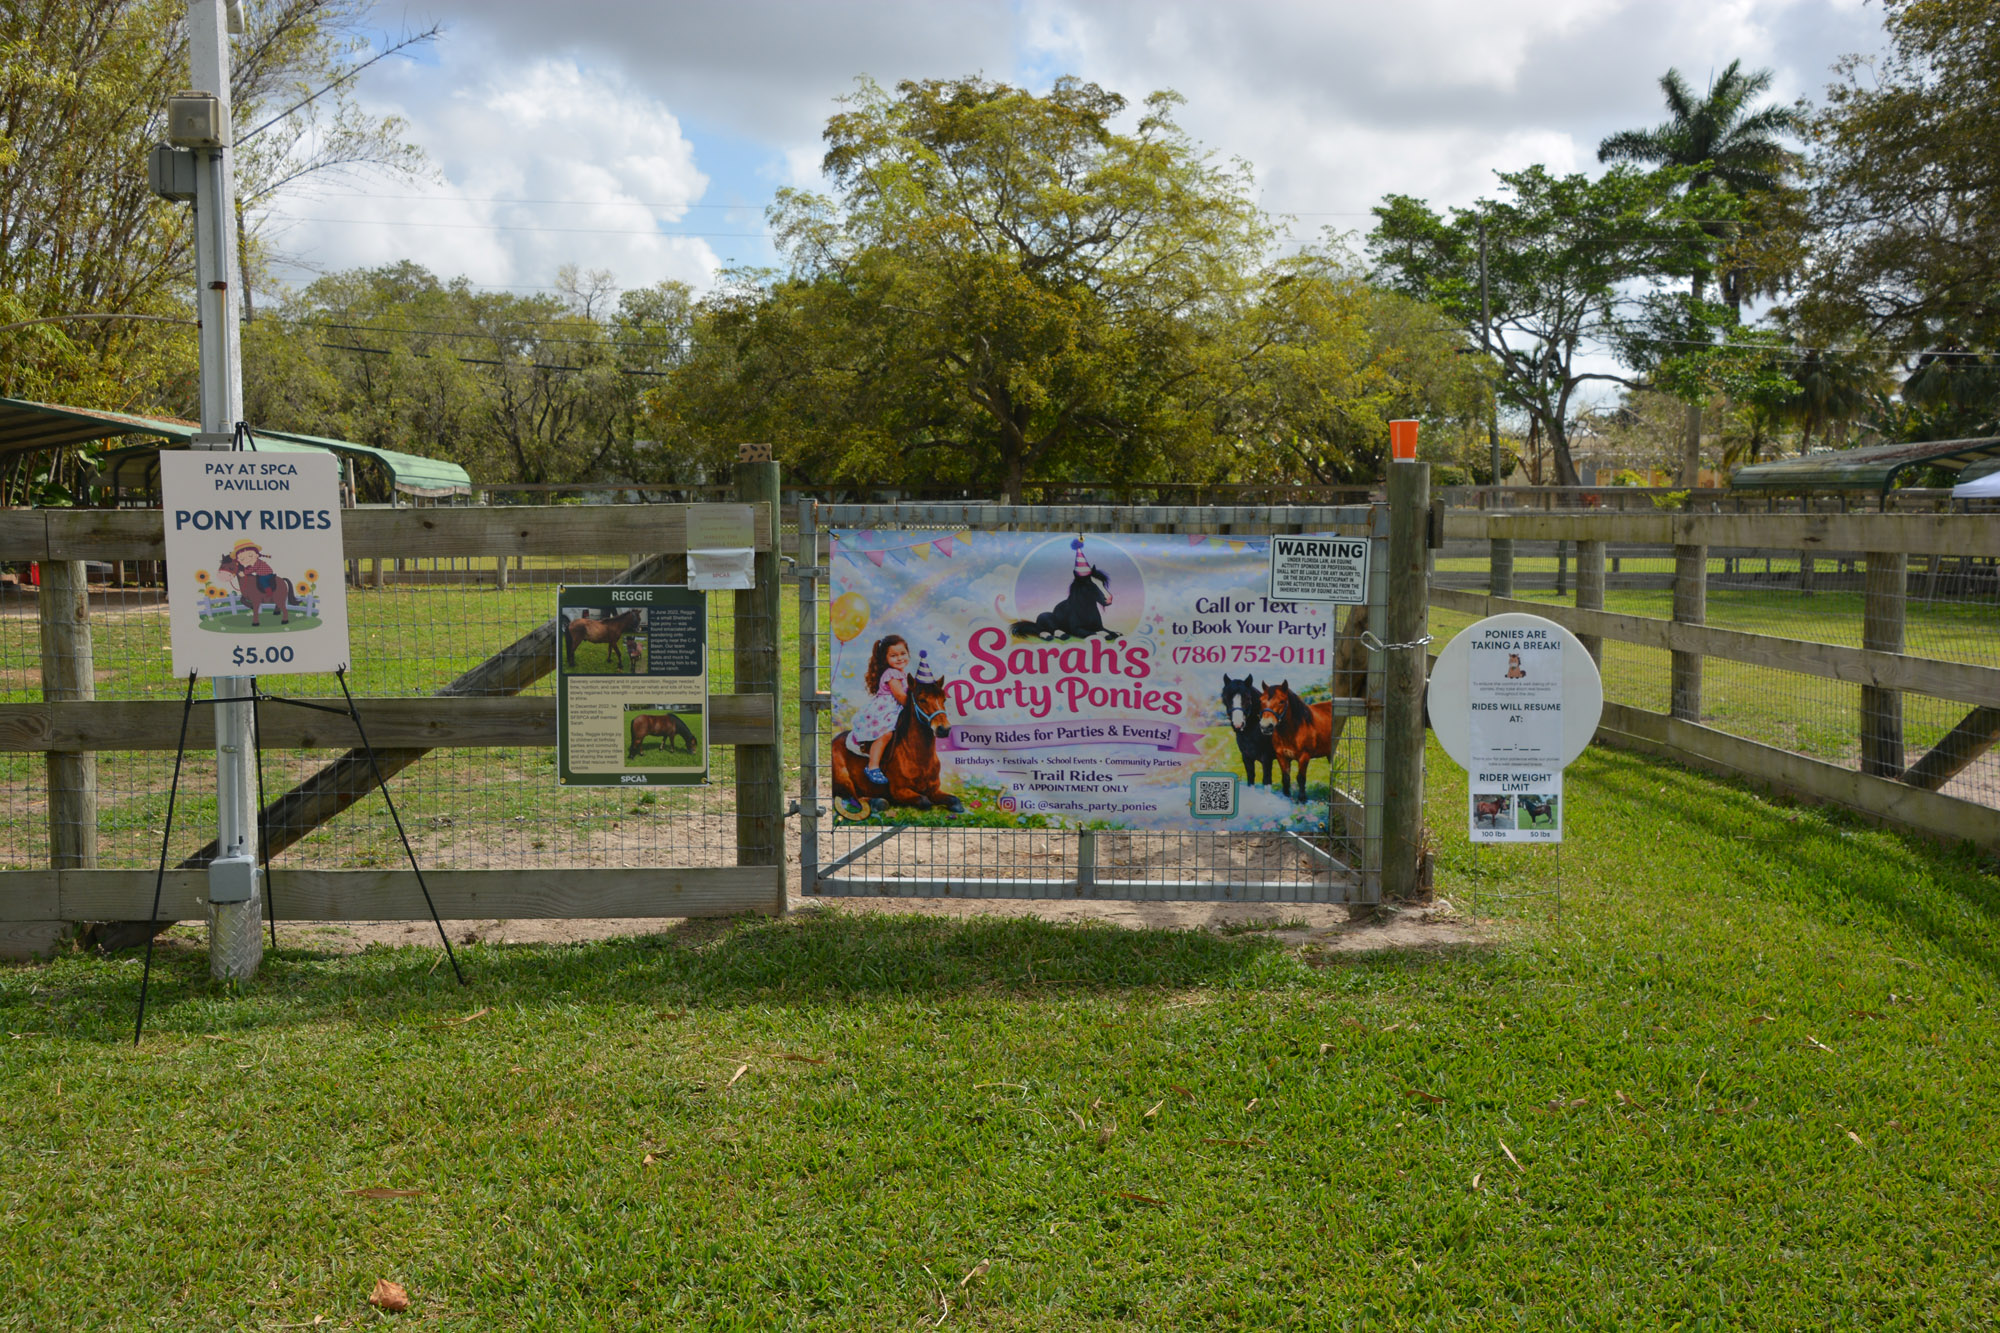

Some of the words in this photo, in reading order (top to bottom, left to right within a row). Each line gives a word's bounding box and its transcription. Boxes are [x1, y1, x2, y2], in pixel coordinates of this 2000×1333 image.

[206, 464, 234, 475] PAY
[238, 464, 255, 475] AT
[260, 464, 297, 475] SPCA
[215, 480, 289, 491] PAVILLION
[175, 510, 252, 530] PONY
[260, 510, 331, 530] RIDES
[1278, 542, 1363, 558] WARNING
[612, 591, 653, 601] REGGIE
[1196, 597, 1230, 614] Call
[1235, 600, 1254, 613] or
[1260, 597, 1298, 614] Text
[1172, 622, 1188, 635] to
[1192, 620, 1232, 634] Book
[1237, 620, 1273, 634] Your
[1278, 621, 1327, 639] Party!
[1485, 630, 1524, 639] PONIES
[1527, 630, 1547, 639] ARE
[1472, 641, 1510, 650] TAKING
[1524, 641, 1561, 650] BREAK!
[232, 646, 294, 666] $5.00
[968, 627, 1150, 684] Sarah's
[1172, 645, 1226, 664] (786)
[1231, 645, 1325, 665] 752-0111
[945, 680, 1050, 718] Party
[1056, 676, 1182, 716] Ponies
[960, 732, 992, 745] Pony
[996, 731, 1030, 743] Rides
[1034, 728, 1052, 740] for
[1057, 726, 1104, 740] Parties
[1108, 726, 1118, 736] &
[1122, 726, 1171, 740] Events!
[955, 757, 994, 766] Birthdays
[1105, 758, 1151, 767] Community
[1030, 770, 1064, 781] Trail
[1070, 770, 1113, 782] Rides
[1479, 774, 1508, 782] RIDER
[1028, 784, 1099, 792] APPOINTMENT
[1102, 784, 1128, 792] ONLY
[1020, 801, 1036, 810] IG:
[1038, 800, 1157, 812] @sarahs_party_ponies
